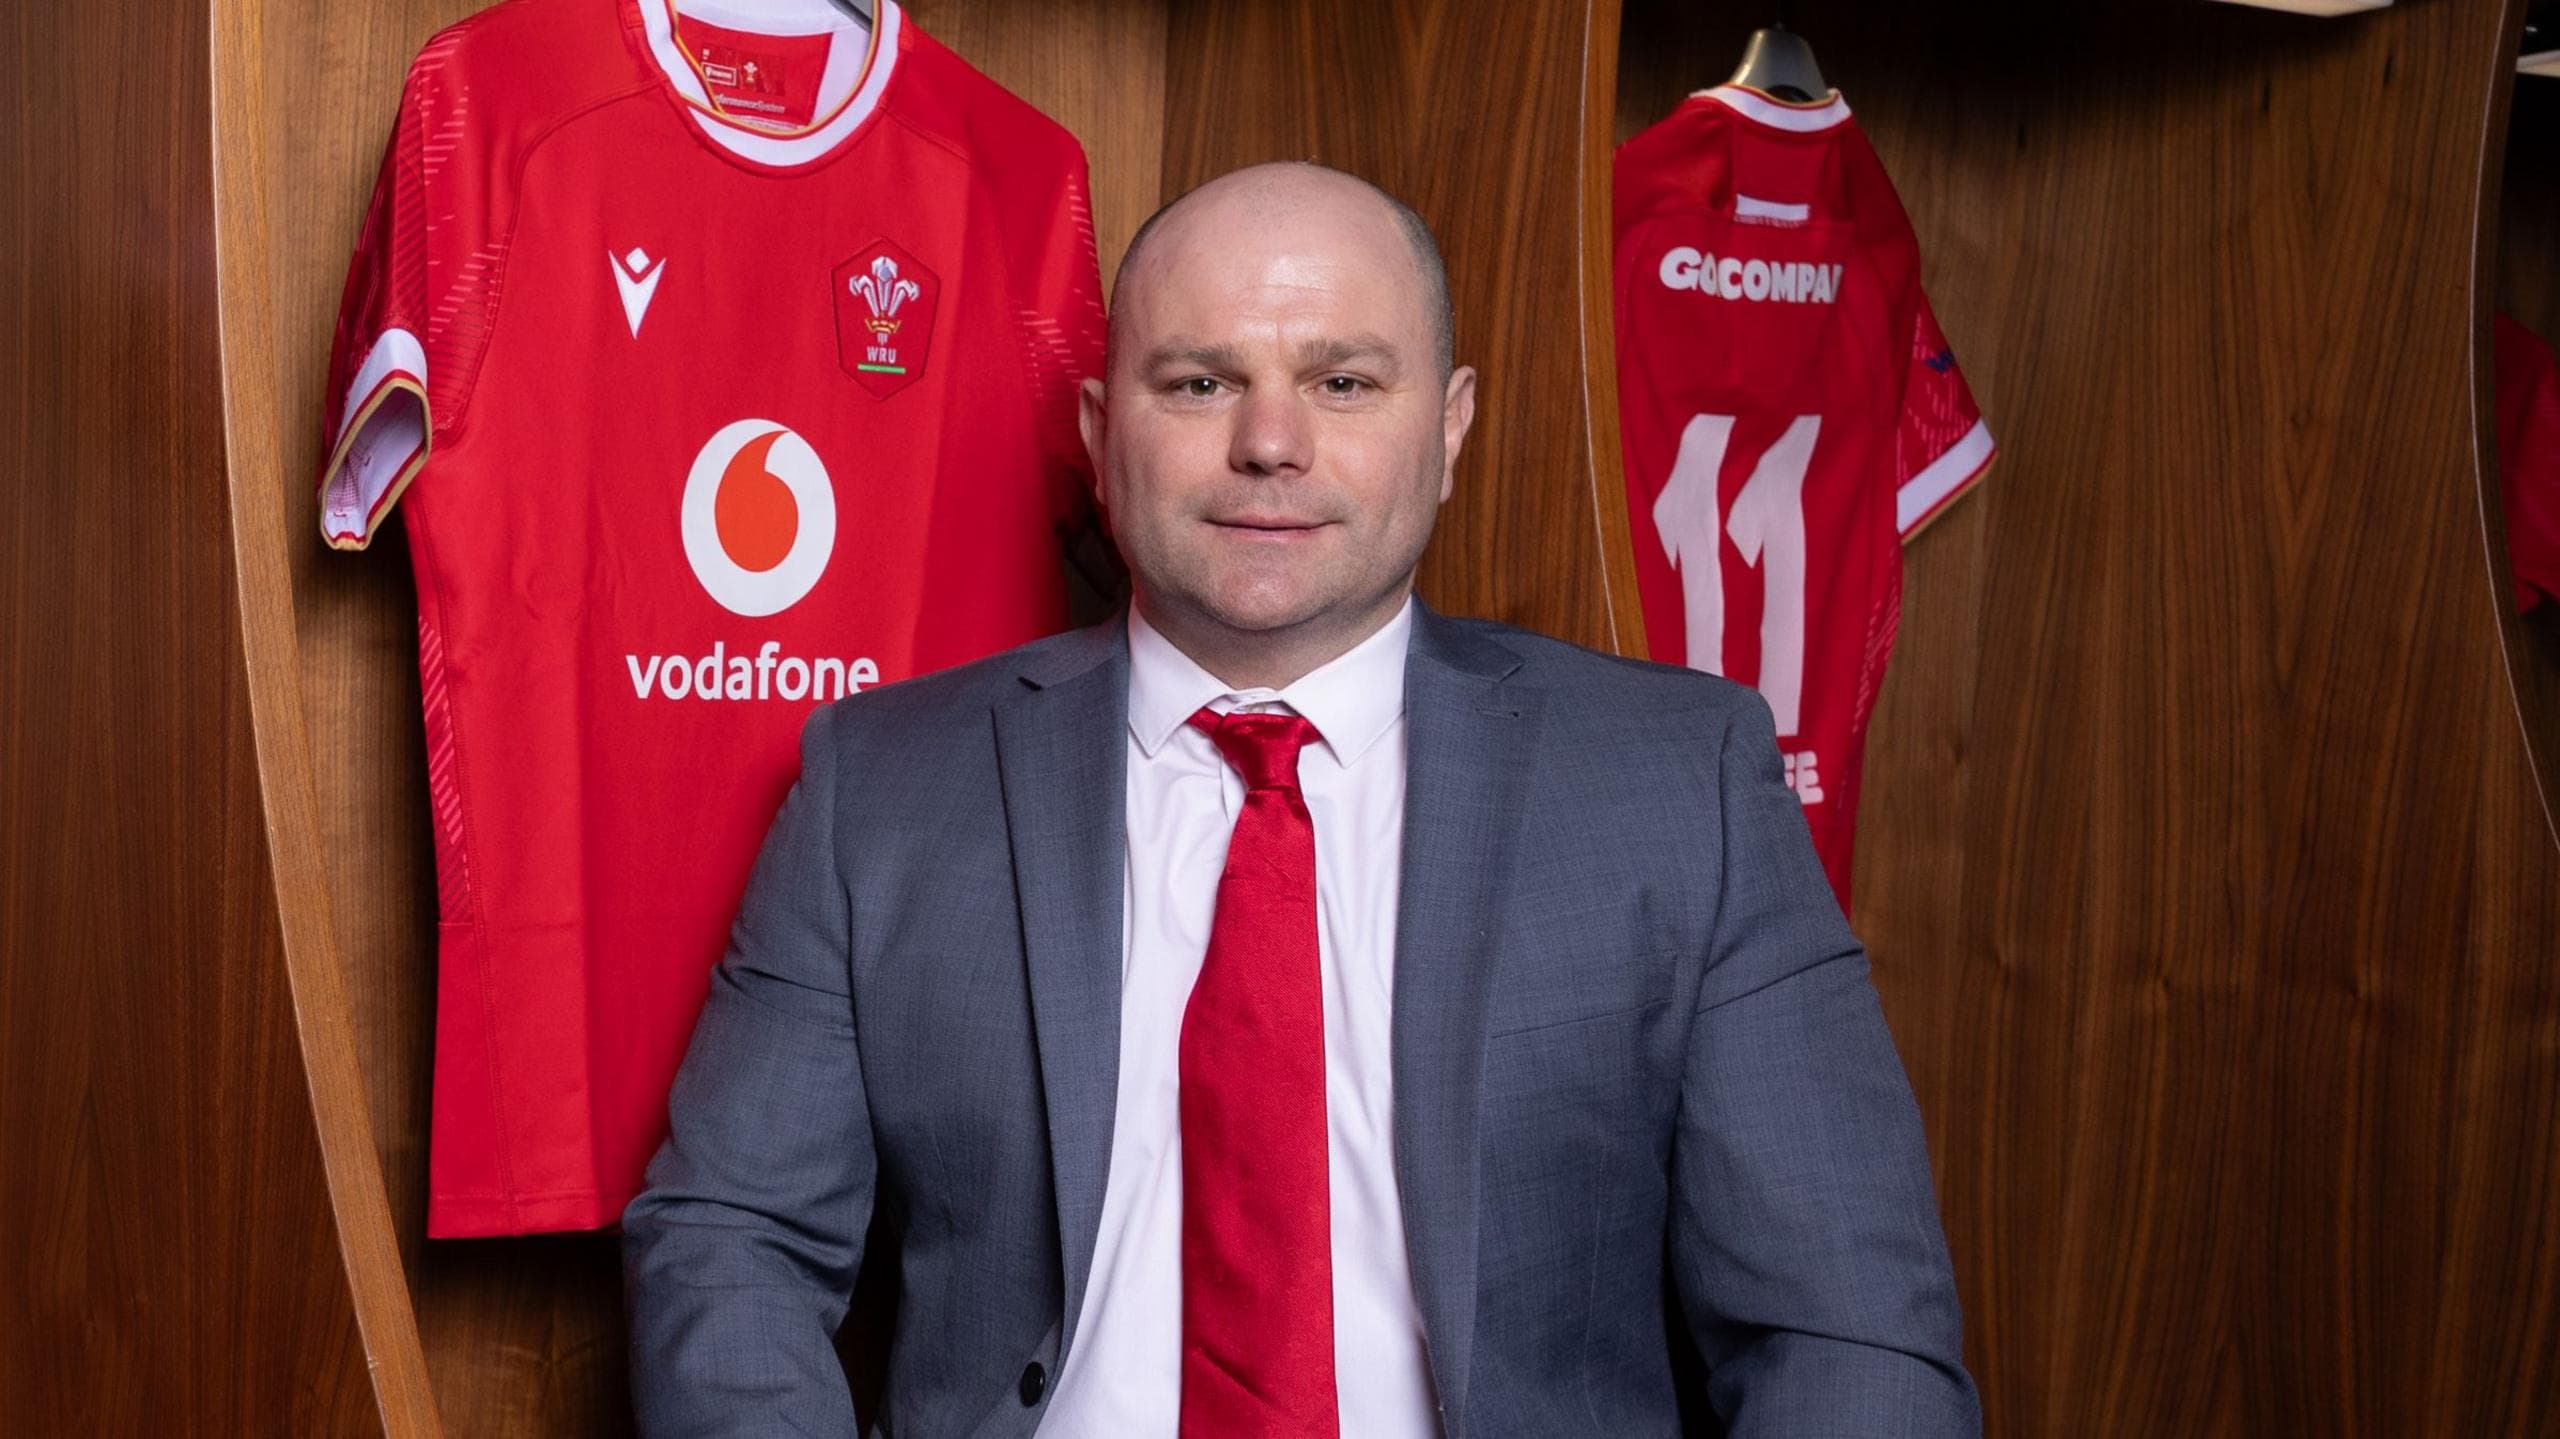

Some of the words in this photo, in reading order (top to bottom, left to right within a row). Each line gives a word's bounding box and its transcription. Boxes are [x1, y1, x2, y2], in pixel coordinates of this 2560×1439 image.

[866, 345, 897, 364] WRU
[1652, 413, 1822, 736] 11
[625, 641, 880, 701] vodafone
